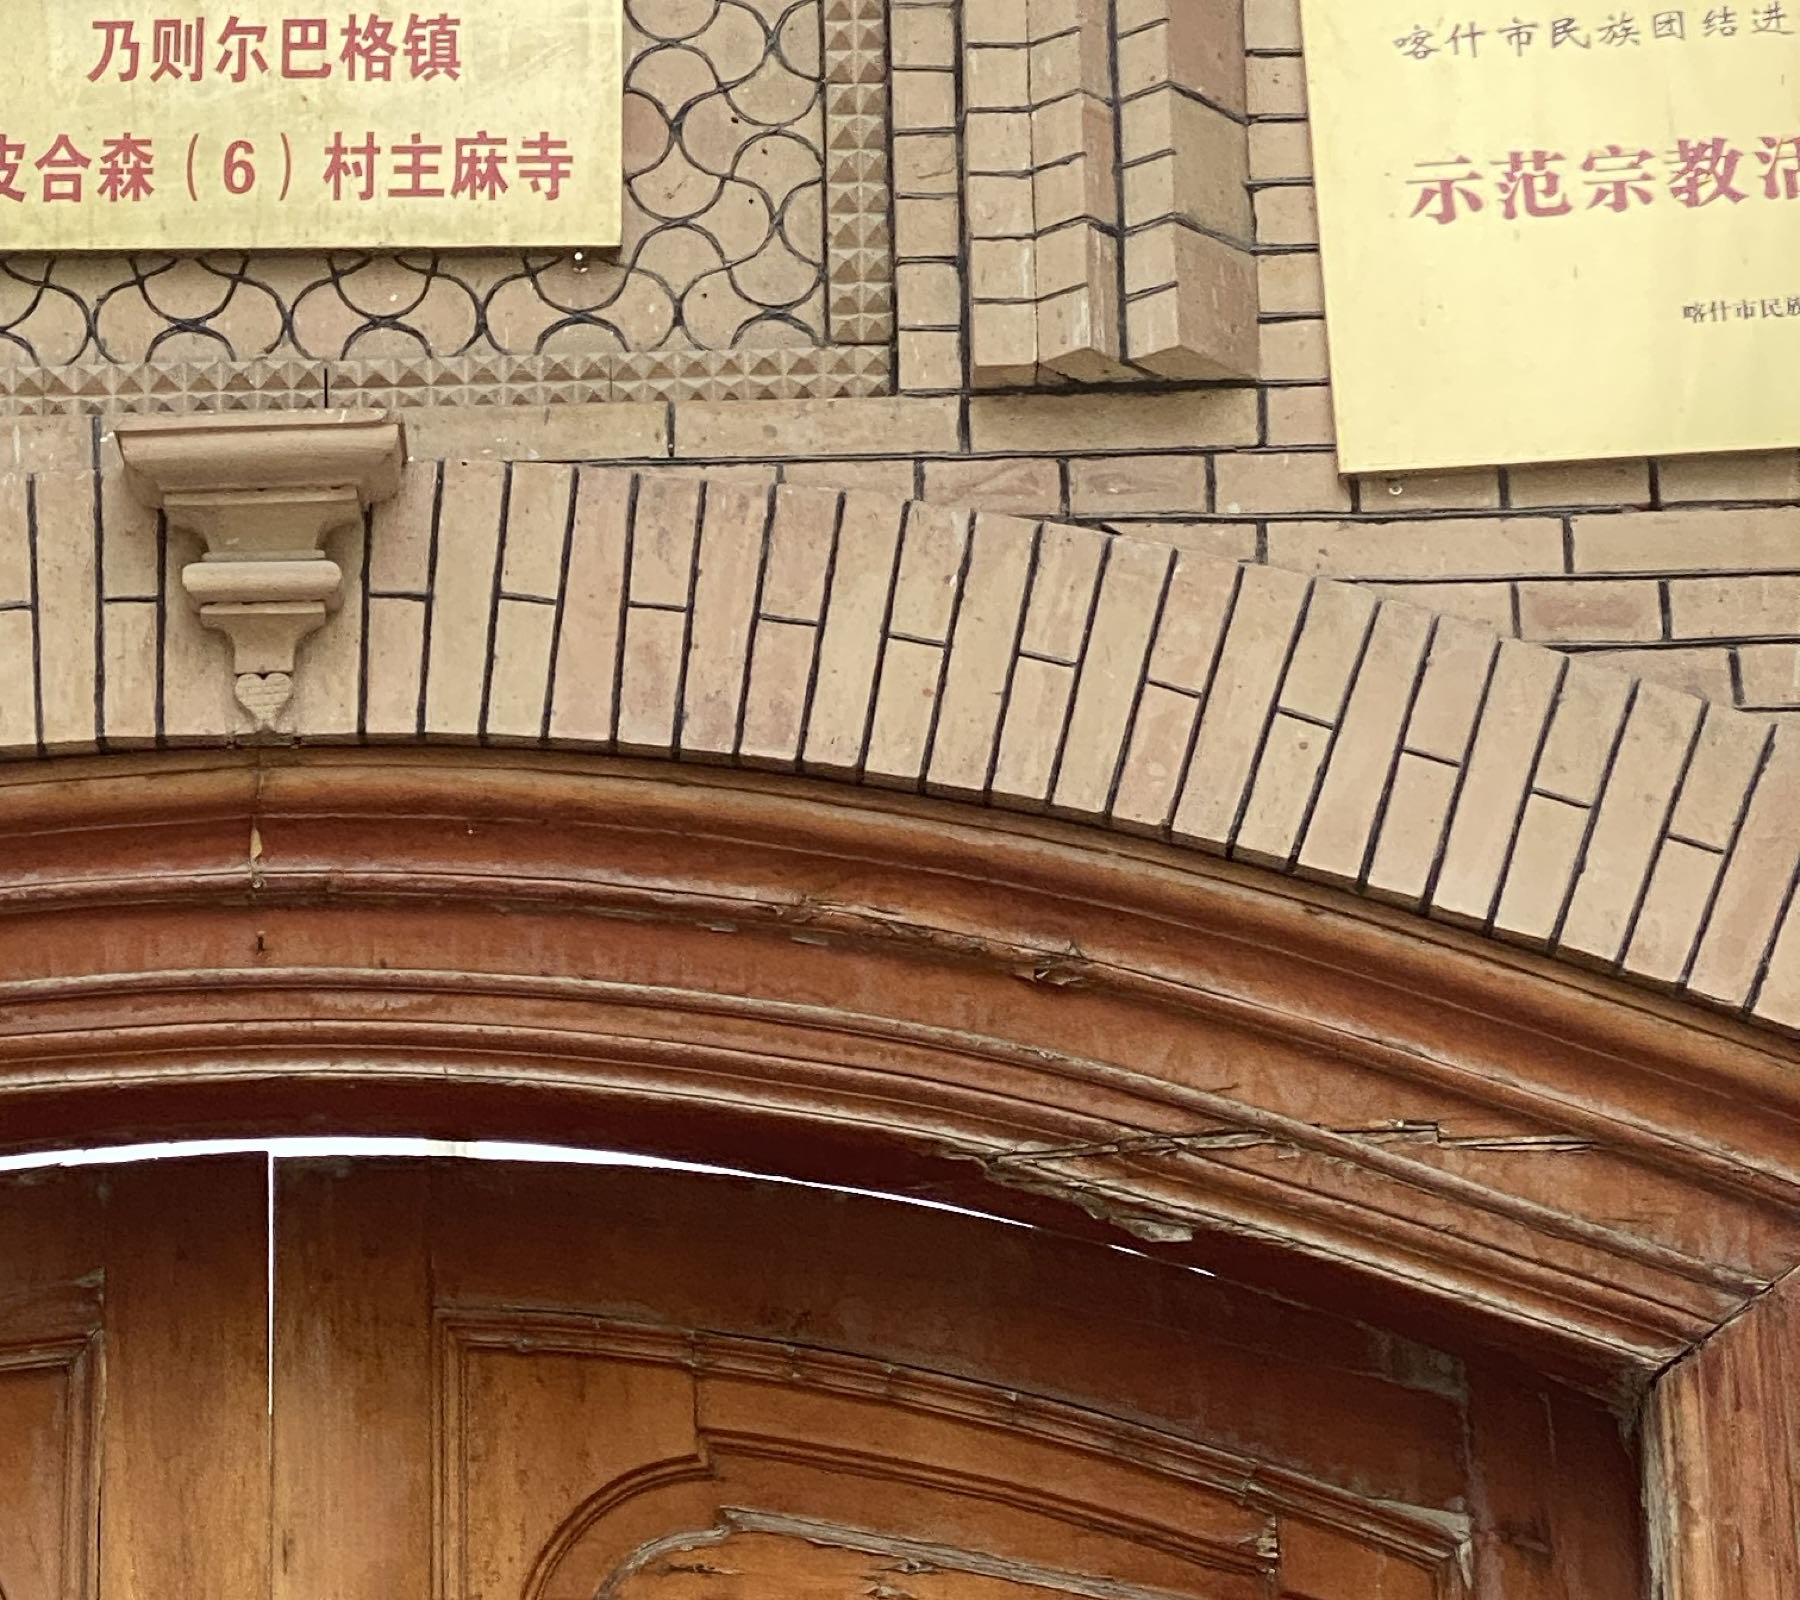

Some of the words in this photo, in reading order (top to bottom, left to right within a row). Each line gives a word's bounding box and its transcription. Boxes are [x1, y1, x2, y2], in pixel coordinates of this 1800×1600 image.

[86, 12, 462, 84] 乃则尔巴格镇
[1393, 0, 1796, 60] 喀什市民族团结进
